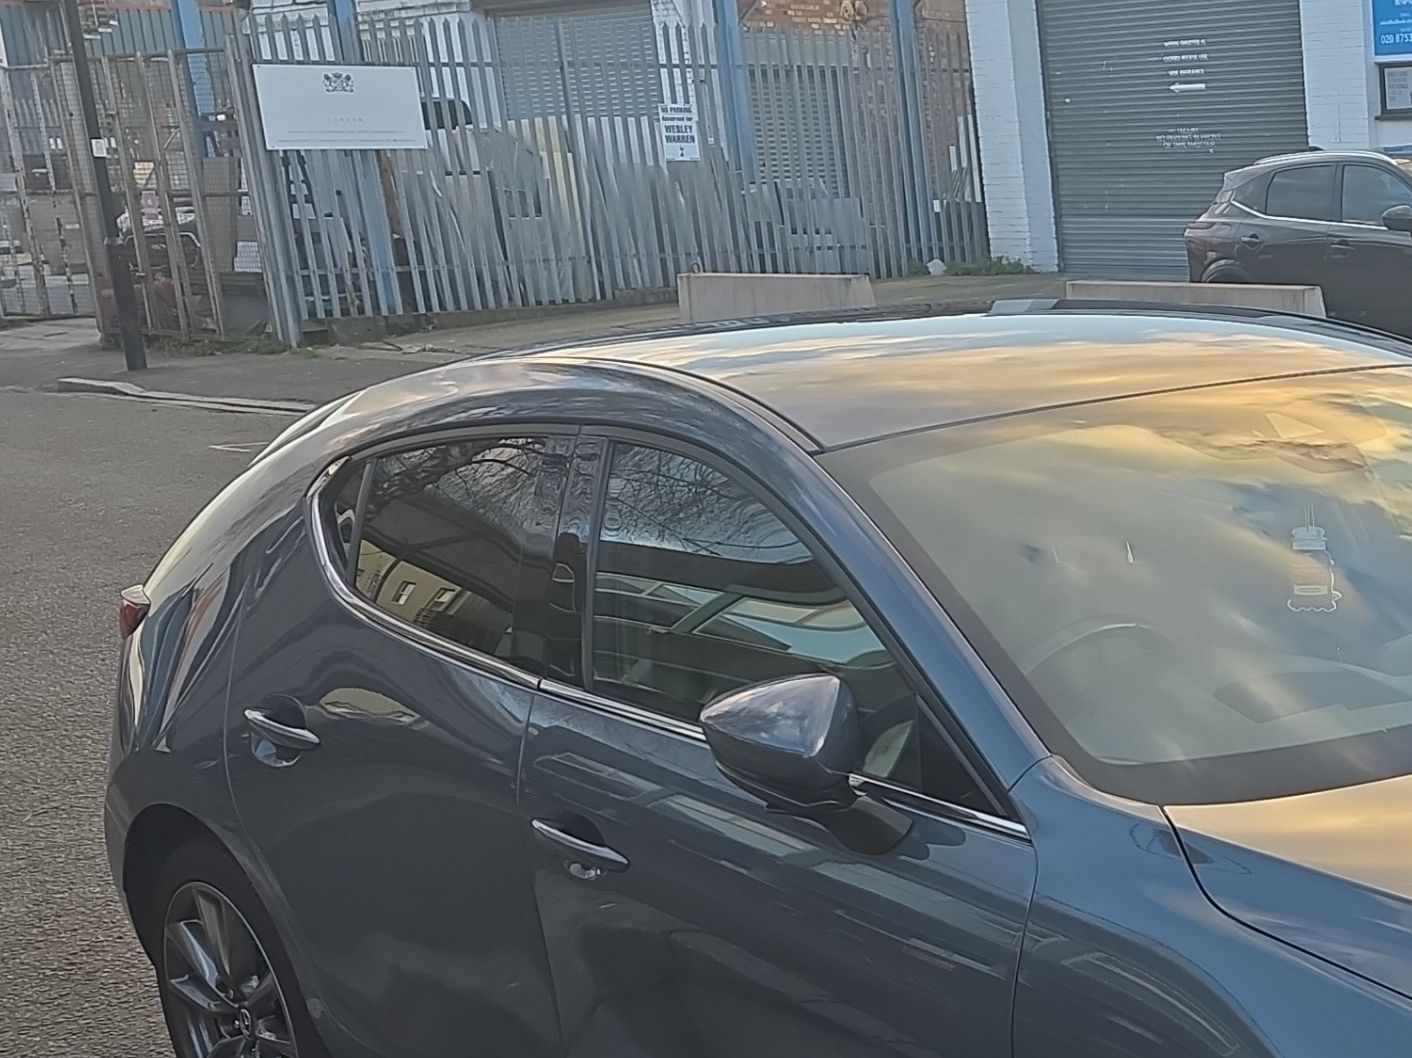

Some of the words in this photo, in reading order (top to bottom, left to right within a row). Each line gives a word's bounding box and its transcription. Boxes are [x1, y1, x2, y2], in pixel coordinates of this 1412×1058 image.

[1380, 34, 1394, 44] 020
[1395, 33, 1412, 43] 8753
[664, 134, 696, 144] WARREN
